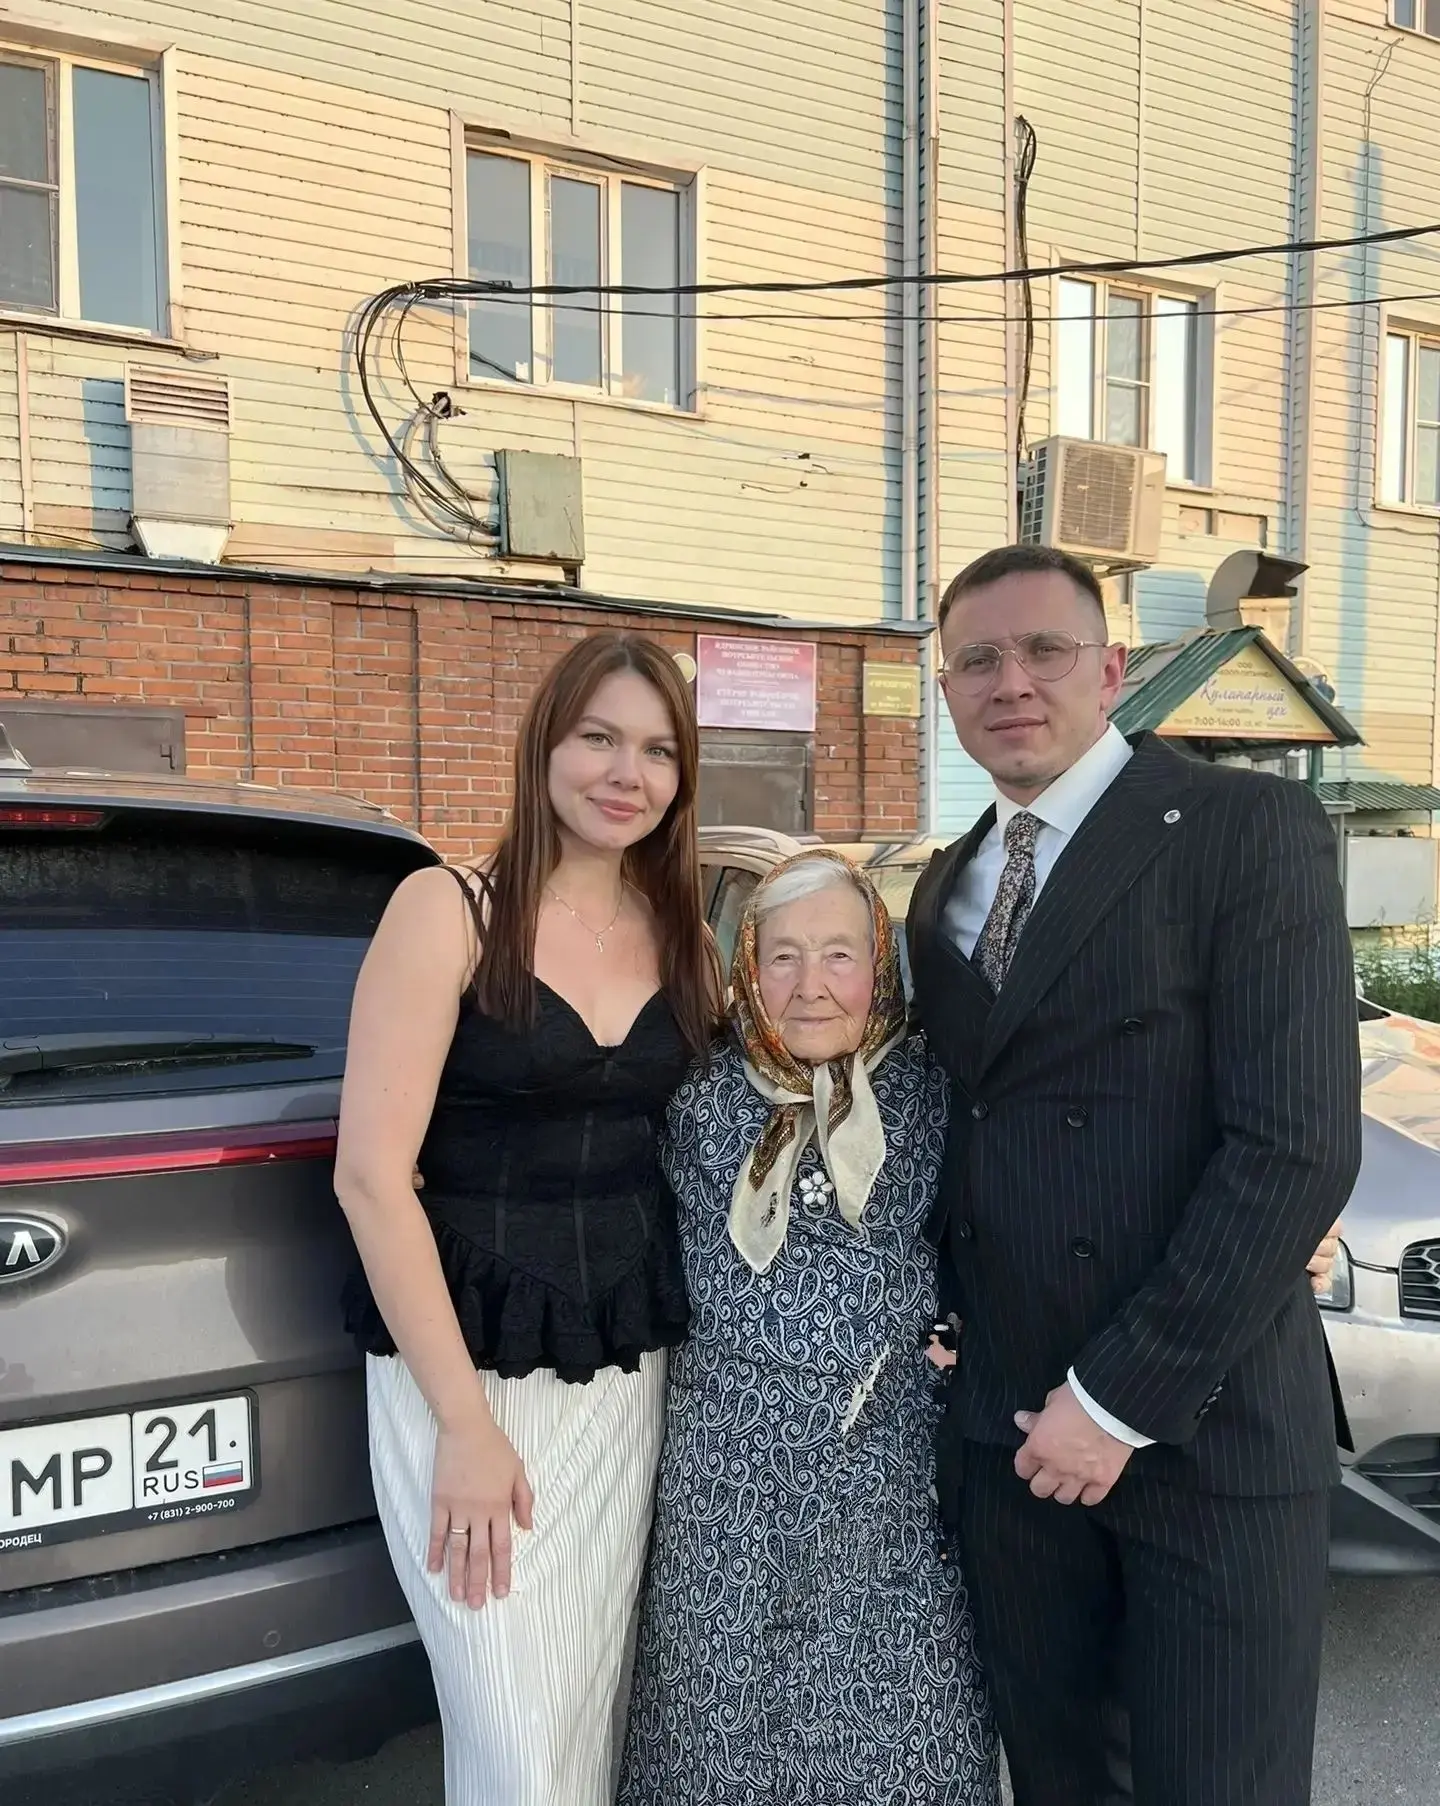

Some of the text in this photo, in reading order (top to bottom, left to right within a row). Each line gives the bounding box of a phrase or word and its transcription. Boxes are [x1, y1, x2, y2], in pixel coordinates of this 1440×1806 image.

[1199, 679, 1285, 706] Кулинарный
[1266, 706, 1288, 720] цех
[144, 1408, 217, 1472] 21
[143, 1470, 199, 1498] RUS
[147, 1498, 235, 1521] +7 (831) 2-900-700
